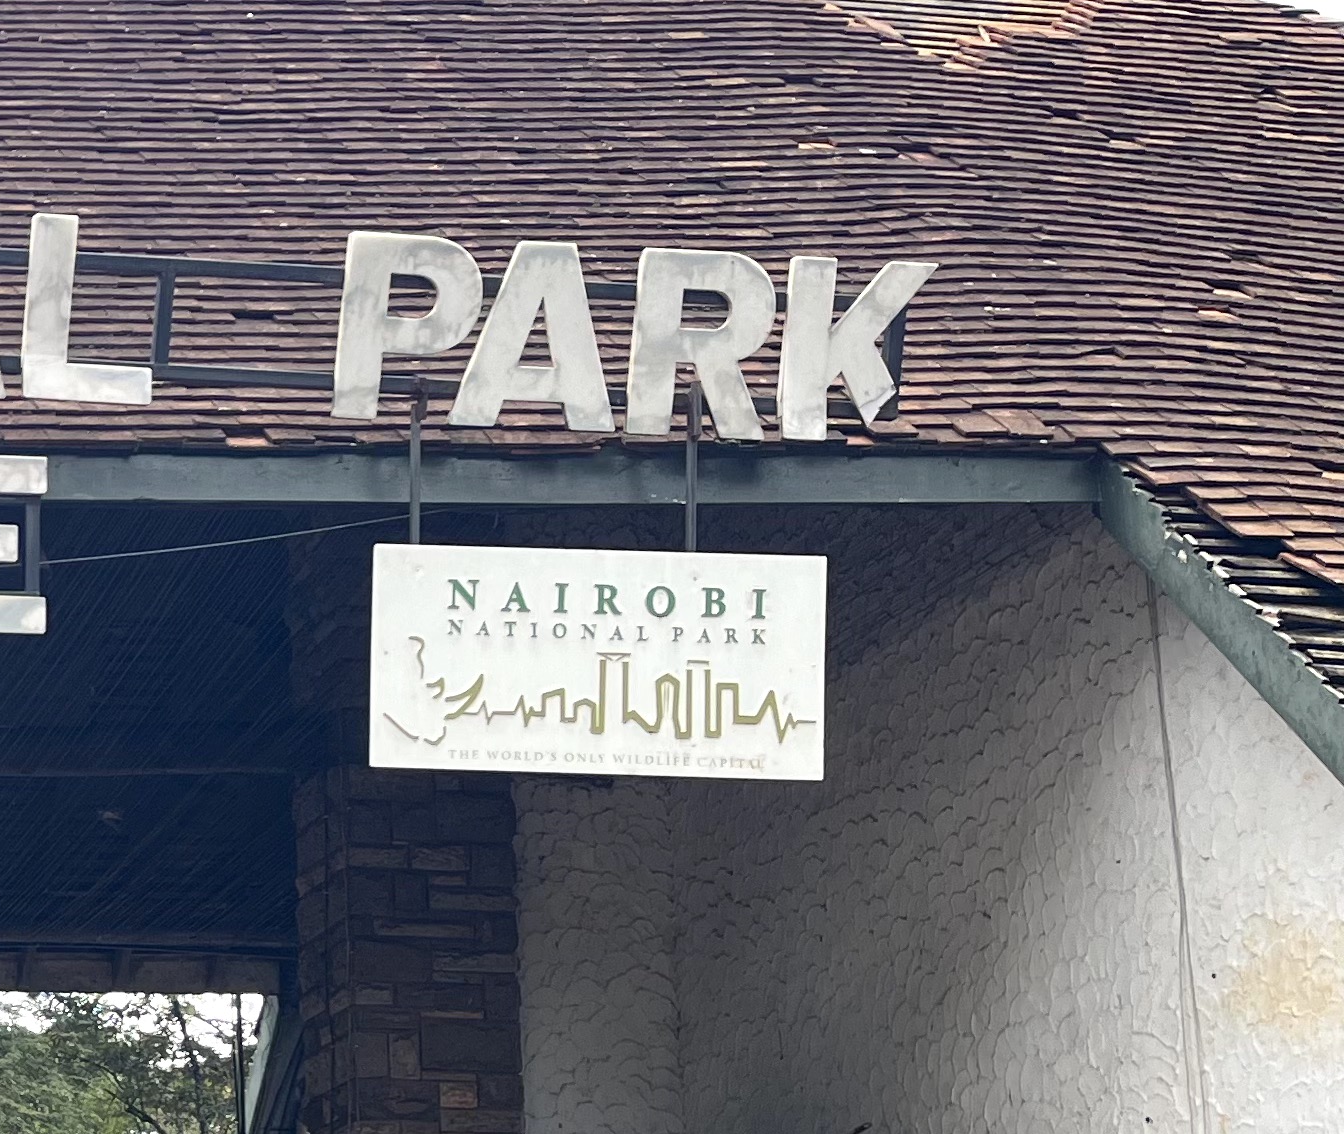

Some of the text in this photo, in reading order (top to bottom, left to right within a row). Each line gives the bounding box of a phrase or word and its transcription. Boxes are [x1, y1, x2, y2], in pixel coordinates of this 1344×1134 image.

[331, 231, 940, 441] PARK
[447, 579, 767, 620] NAIROBI
[447, 619, 767, 645] NATIONAL PARK
[448, 749, 480, 760] THE
[564, 752, 606, 764] ONLY
[613, 753, 691, 767] WILDLIFE
